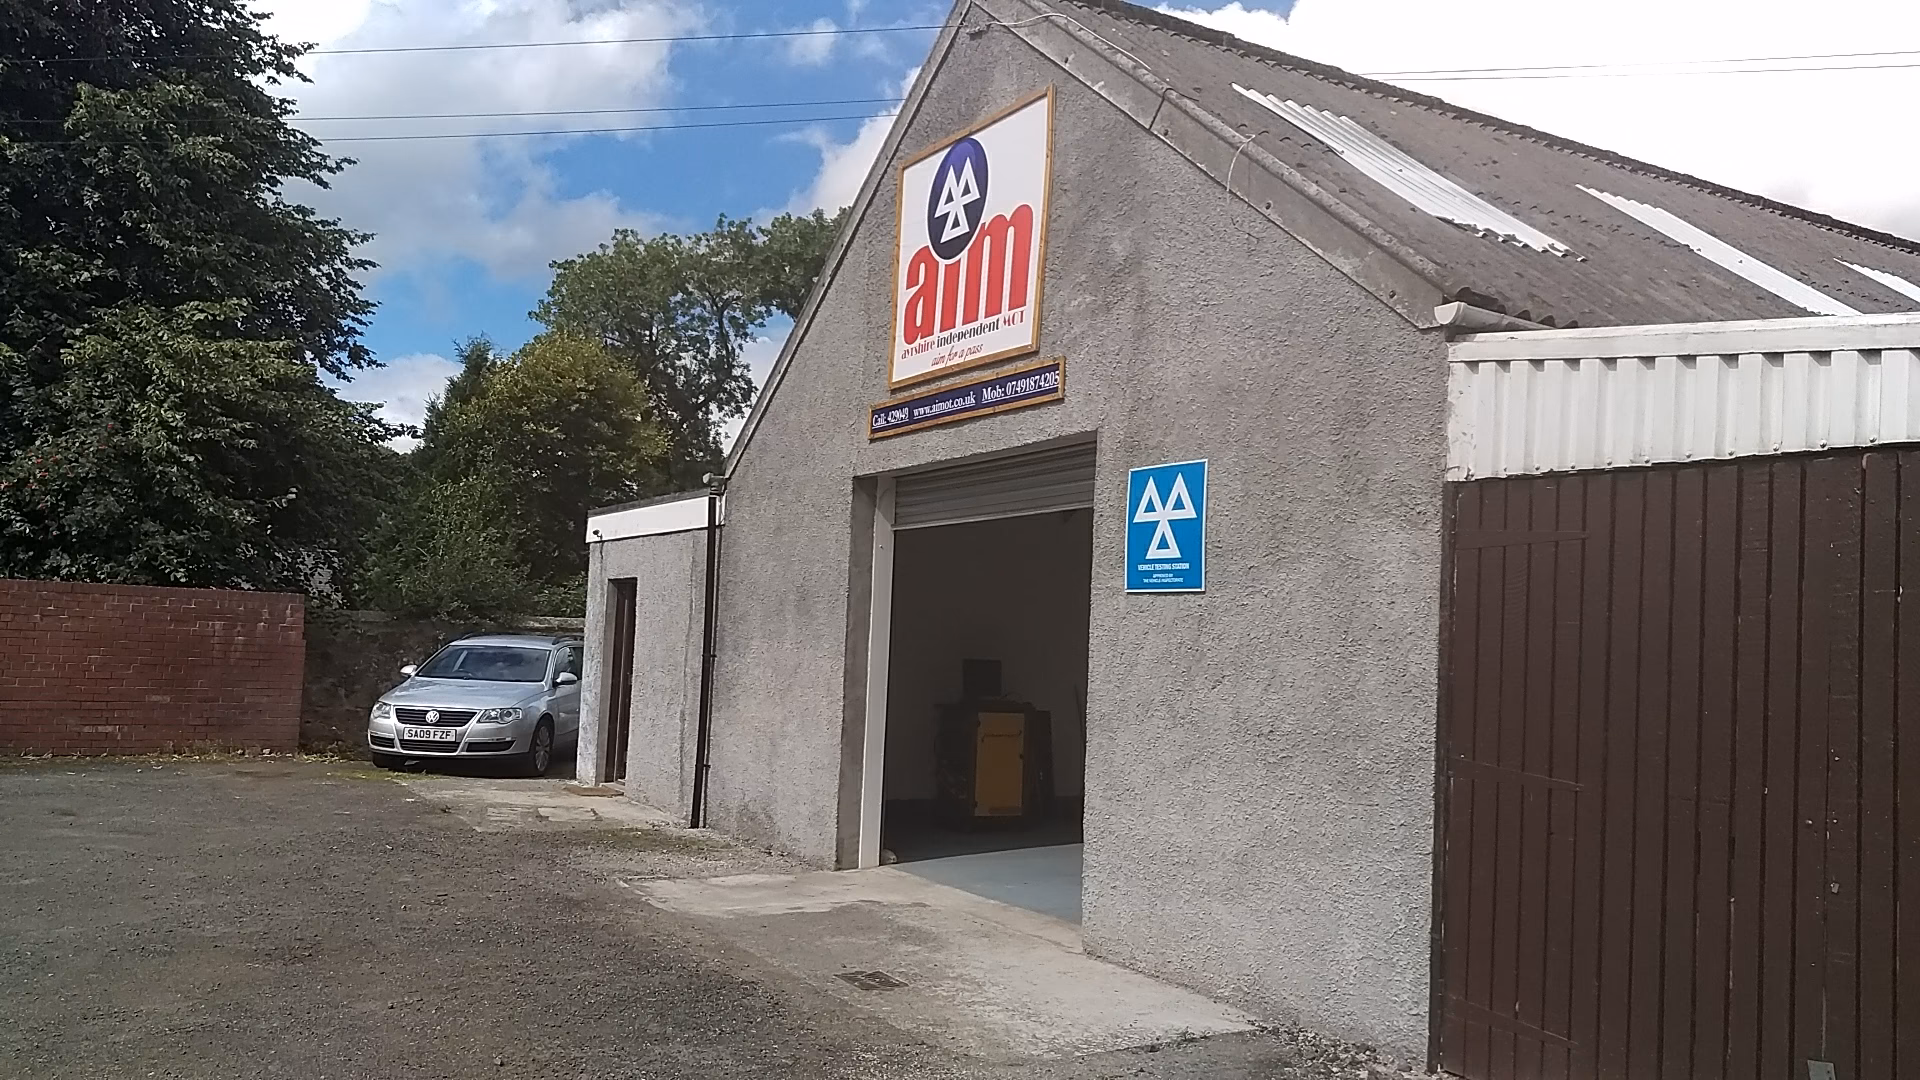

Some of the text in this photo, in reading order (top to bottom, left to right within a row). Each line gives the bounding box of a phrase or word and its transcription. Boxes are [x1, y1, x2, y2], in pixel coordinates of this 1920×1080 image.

[903, 203, 1034, 346] aim
[901, 309, 1026, 360] ayrshire independent MOT
[931, 343, 984, 368] aim for a pass
[872, 412, 887, 427] Call:
[913, 391, 976, 417] www.aimot.co.uk
[982, 385, 1005, 402] Mob:
[1006, 371, 1060, 396] 07491874205
[407, 728, 452, 740] SA09 FZF
